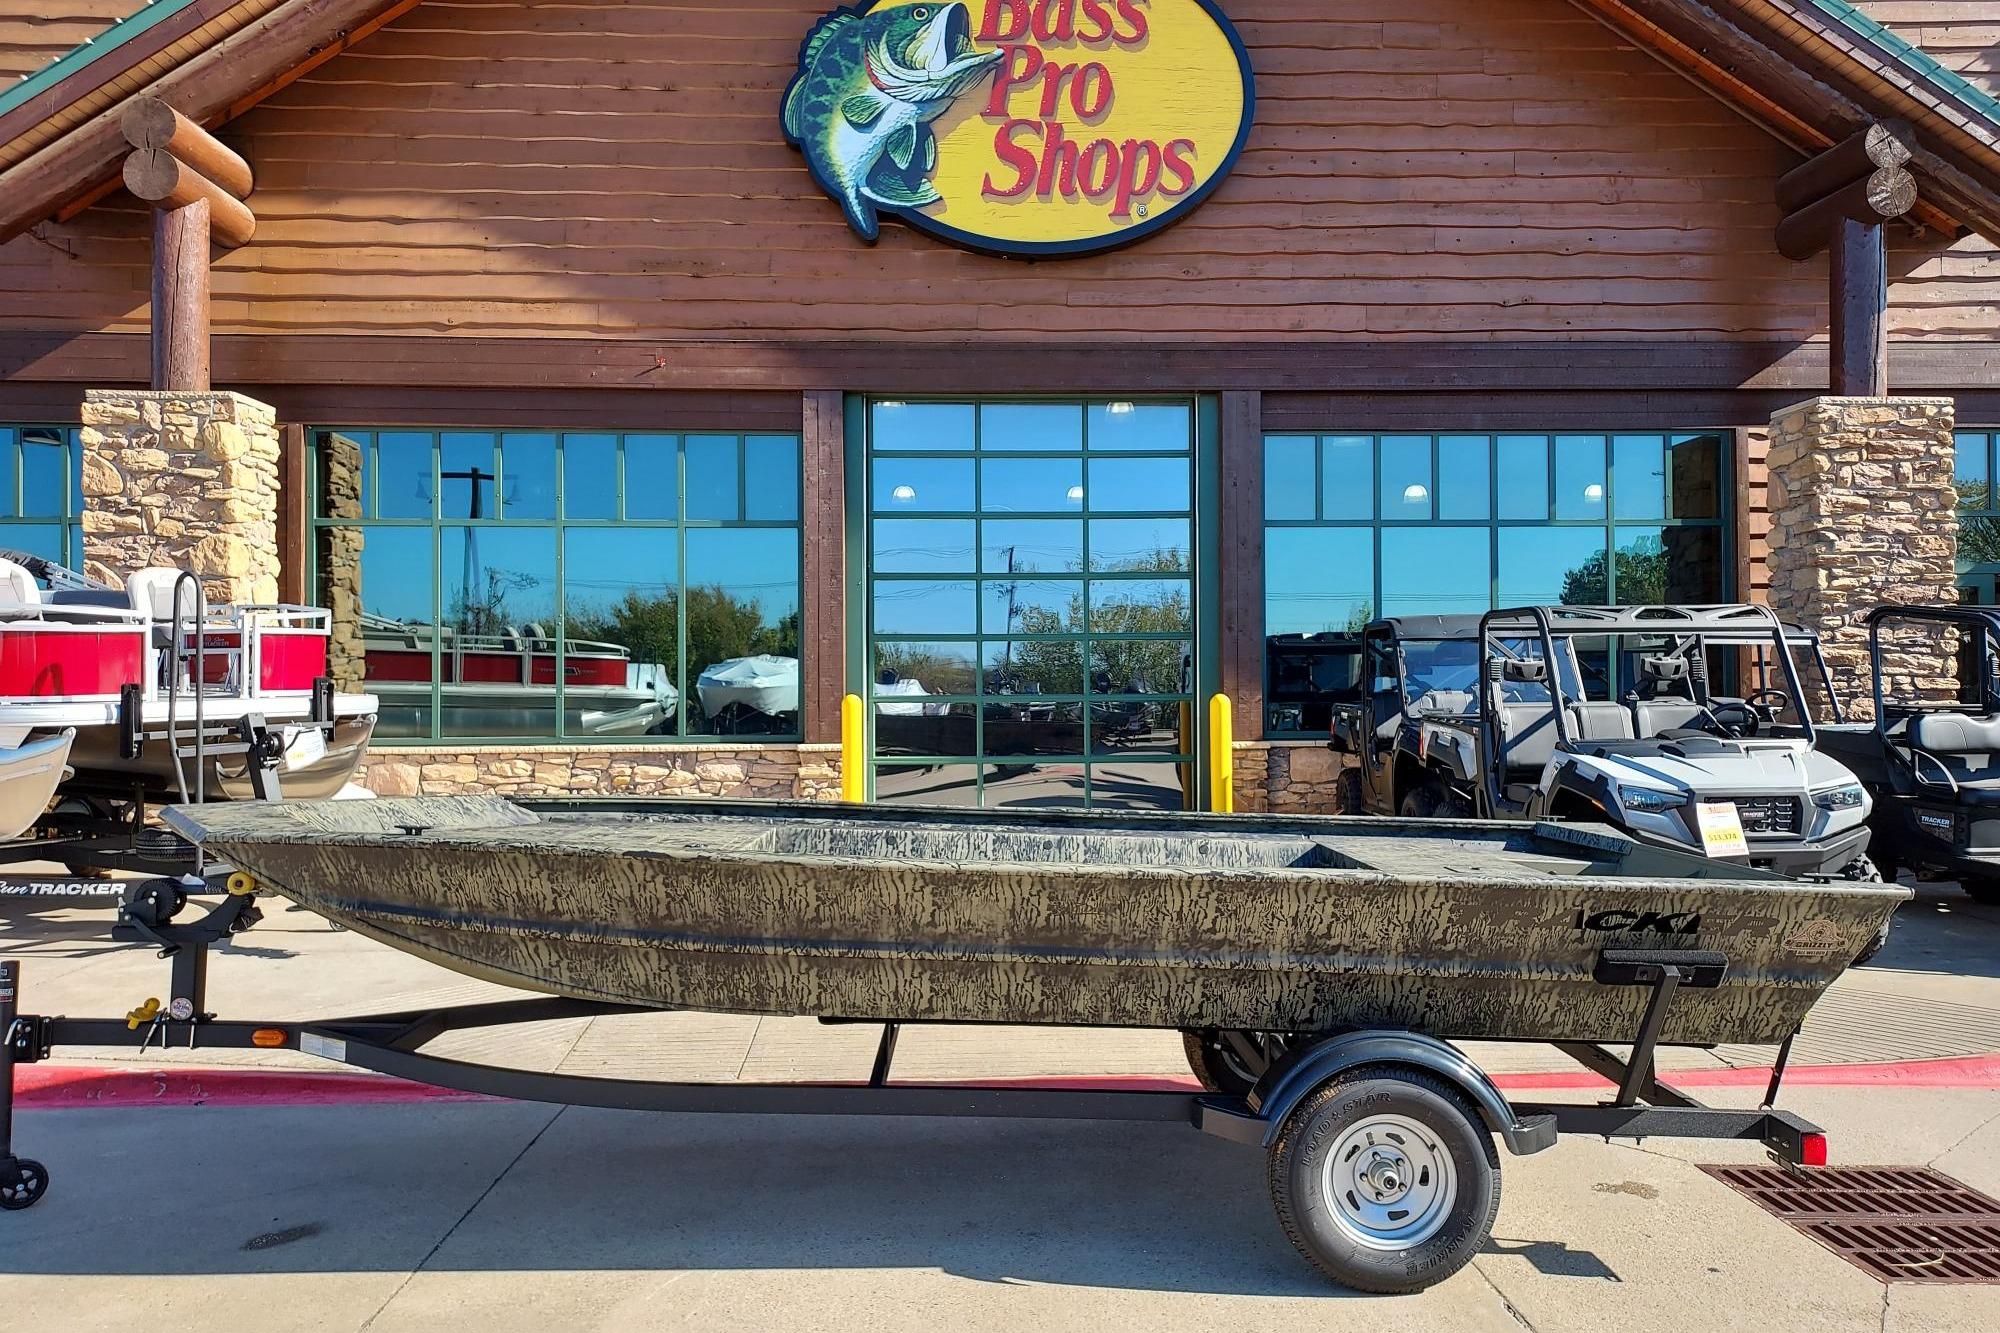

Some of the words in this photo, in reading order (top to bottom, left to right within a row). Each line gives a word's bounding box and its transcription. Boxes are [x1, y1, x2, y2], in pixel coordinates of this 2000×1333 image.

[975, 0, 1148, 43] Bass
[980, 44, 1113, 118] Pro
[982, 119, 1195, 217] Shops
[1921, 815, 1950, 825] TRACKER
[30, 883, 126, 895] TRACKER
[1302, 1119, 1332, 1167] LOAD
[1342, 1092, 1392, 1115] STAR
